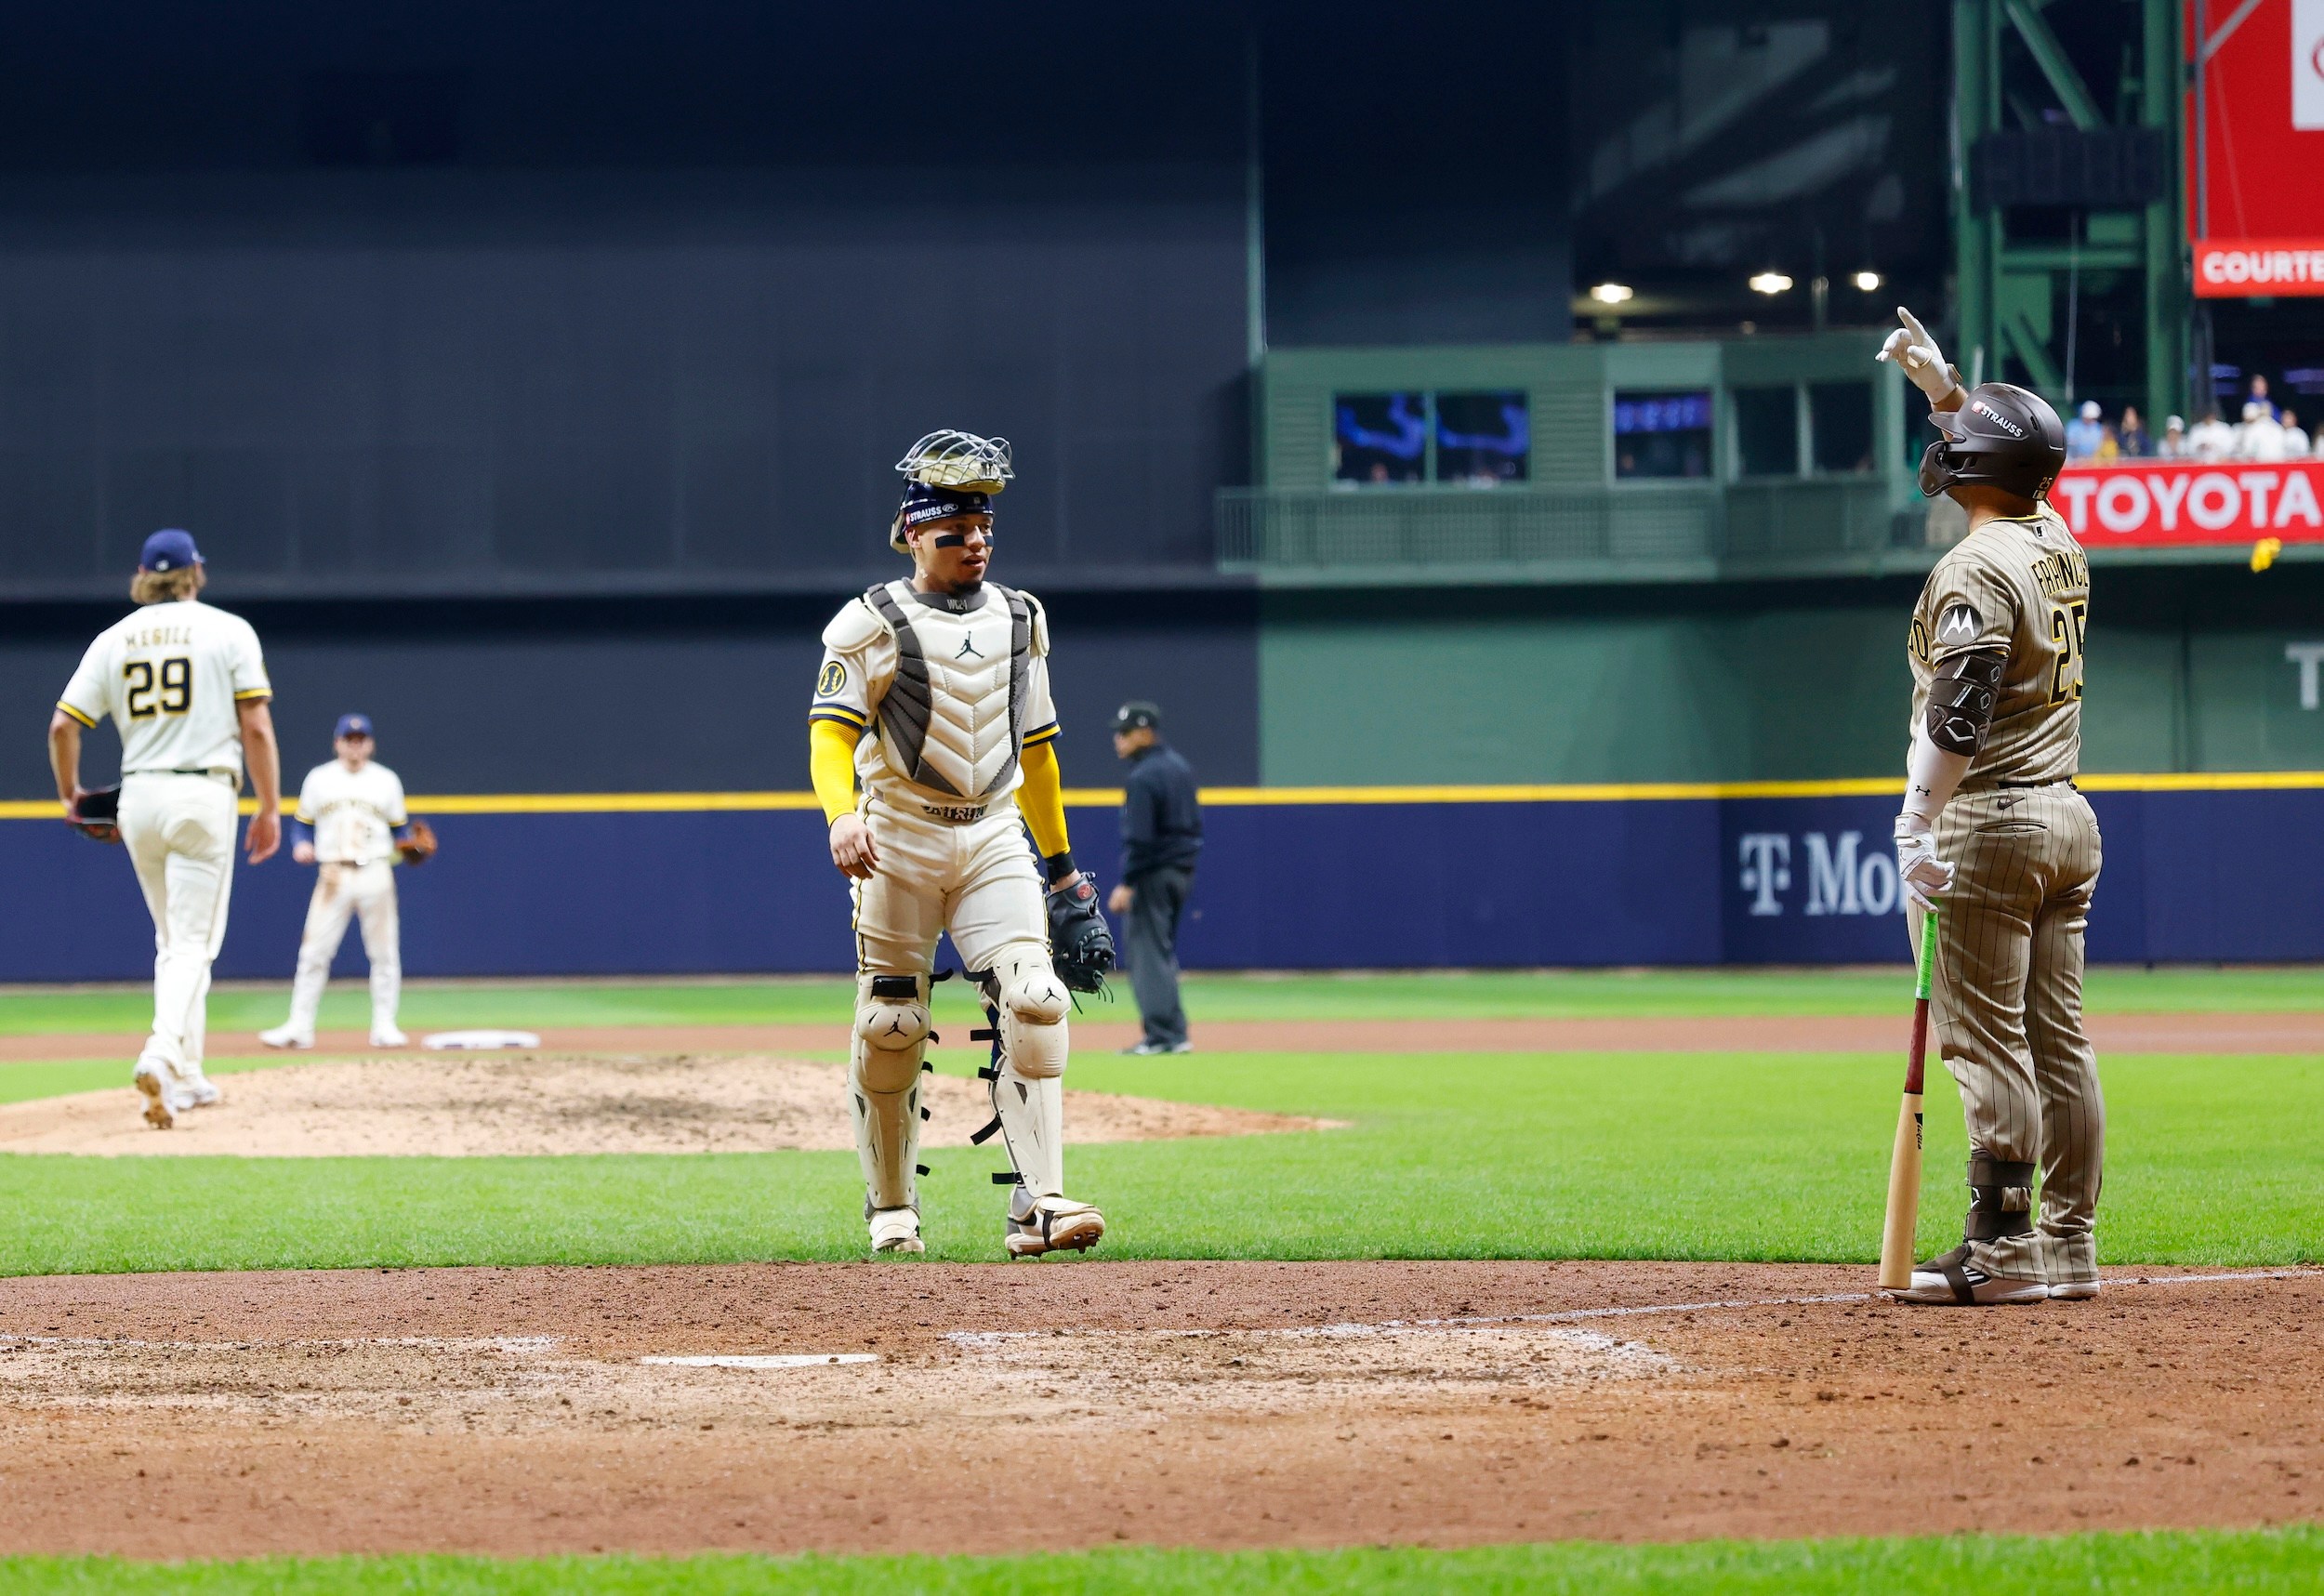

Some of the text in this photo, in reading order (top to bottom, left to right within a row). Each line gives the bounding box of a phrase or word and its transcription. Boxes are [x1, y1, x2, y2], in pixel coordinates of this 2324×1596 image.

[1981, 405, 2023, 437] STRAUSS
[910, 506, 942, 522] STRAUSS
[2059, 470, 2322, 534] TOYOTA
[2048, 600, 2086, 707] 25
[123, 656, 192, 720] 29
[1803, 830, 1907, 916] Mo
